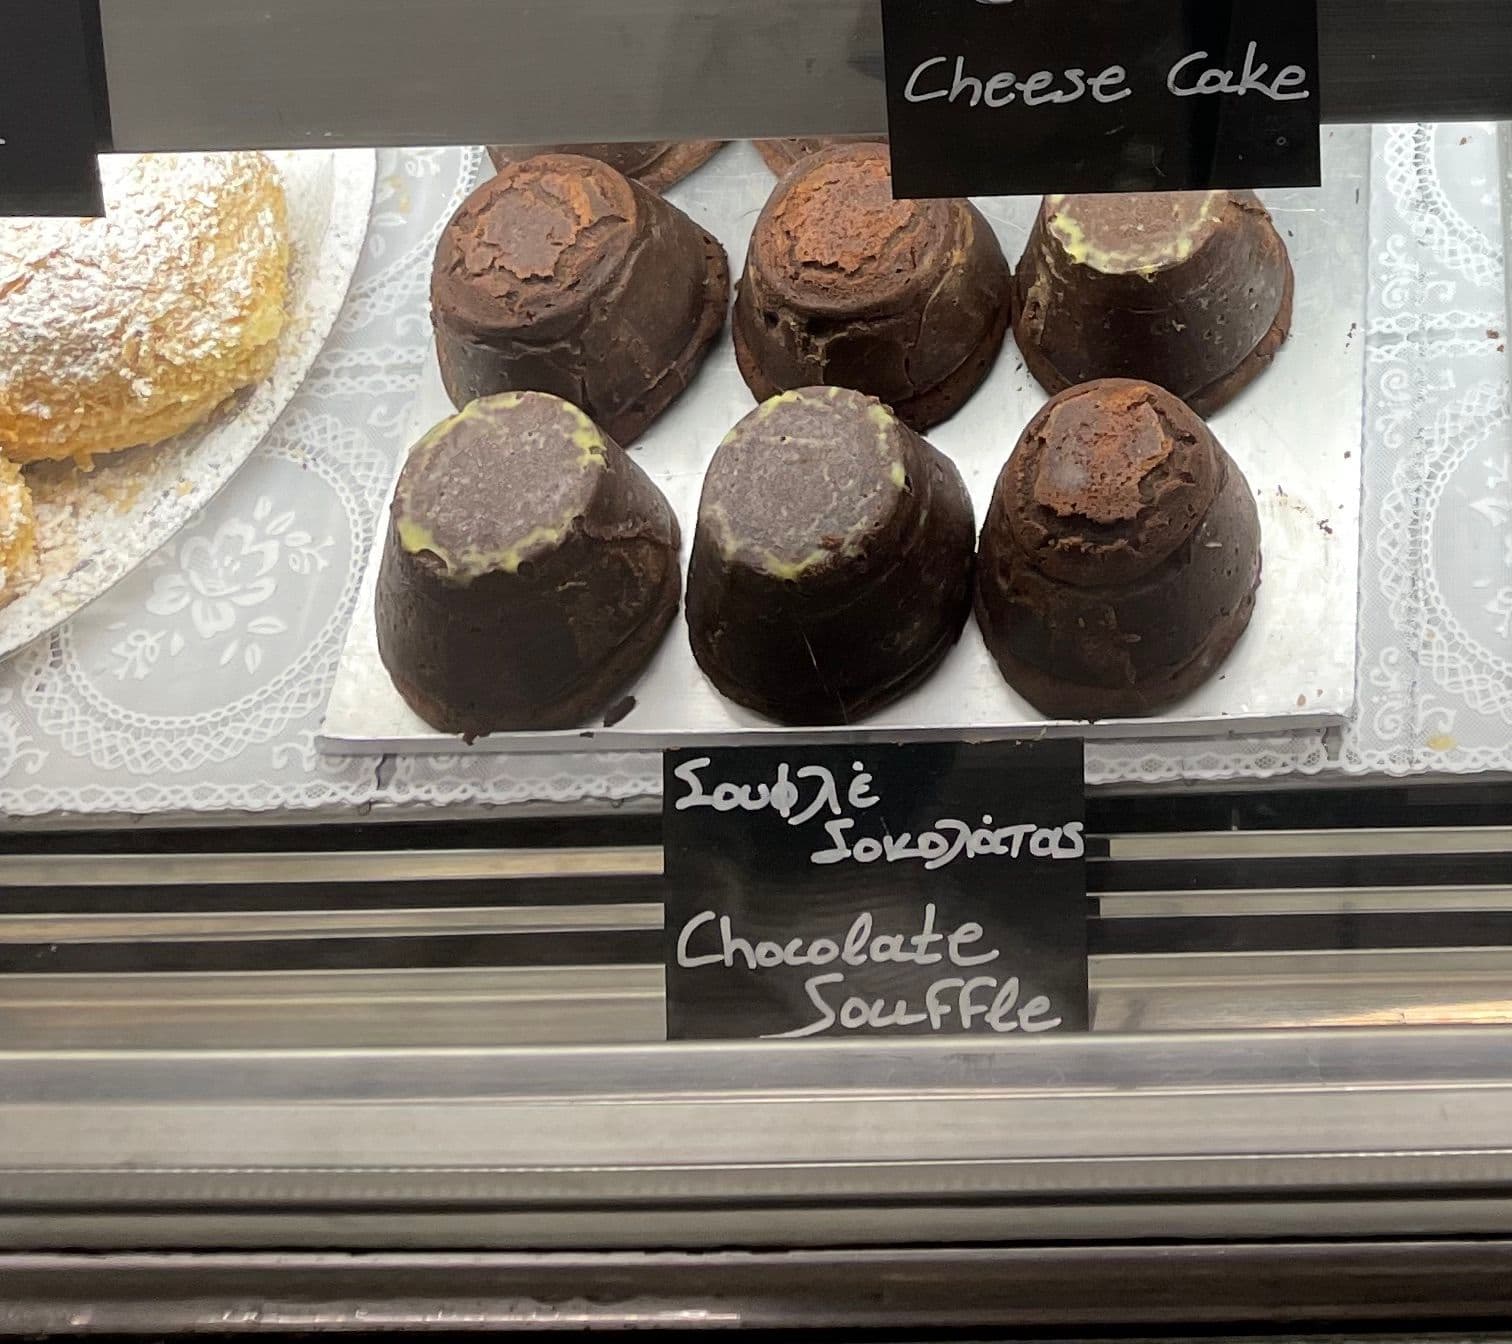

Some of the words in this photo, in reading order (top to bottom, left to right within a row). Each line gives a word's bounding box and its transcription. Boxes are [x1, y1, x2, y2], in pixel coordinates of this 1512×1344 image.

[904, 56, 1131, 107] Cheese
[1166, 41, 1309, 100] Cake
[677, 903, 1000, 970] Chocolate
